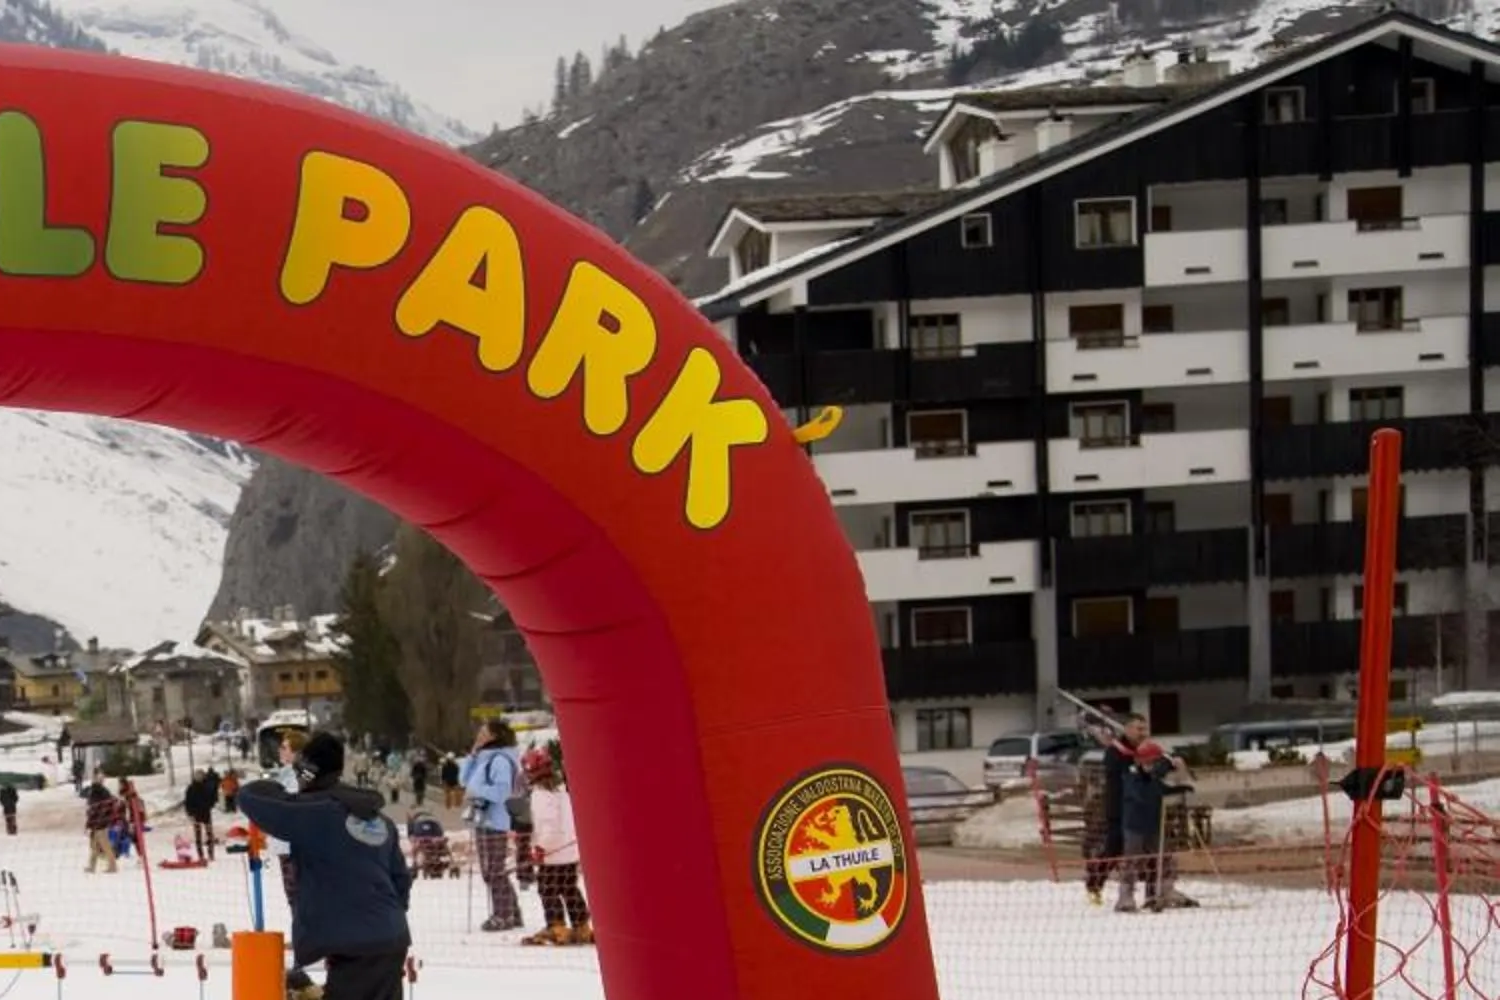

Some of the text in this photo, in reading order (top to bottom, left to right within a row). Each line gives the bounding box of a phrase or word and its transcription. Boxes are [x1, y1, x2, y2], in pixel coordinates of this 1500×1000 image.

[279, 150, 768, 530] PARK
[766, 798, 801, 880] ASSOCIAZIONE
[810, 848, 879, 872] LA THUILE
